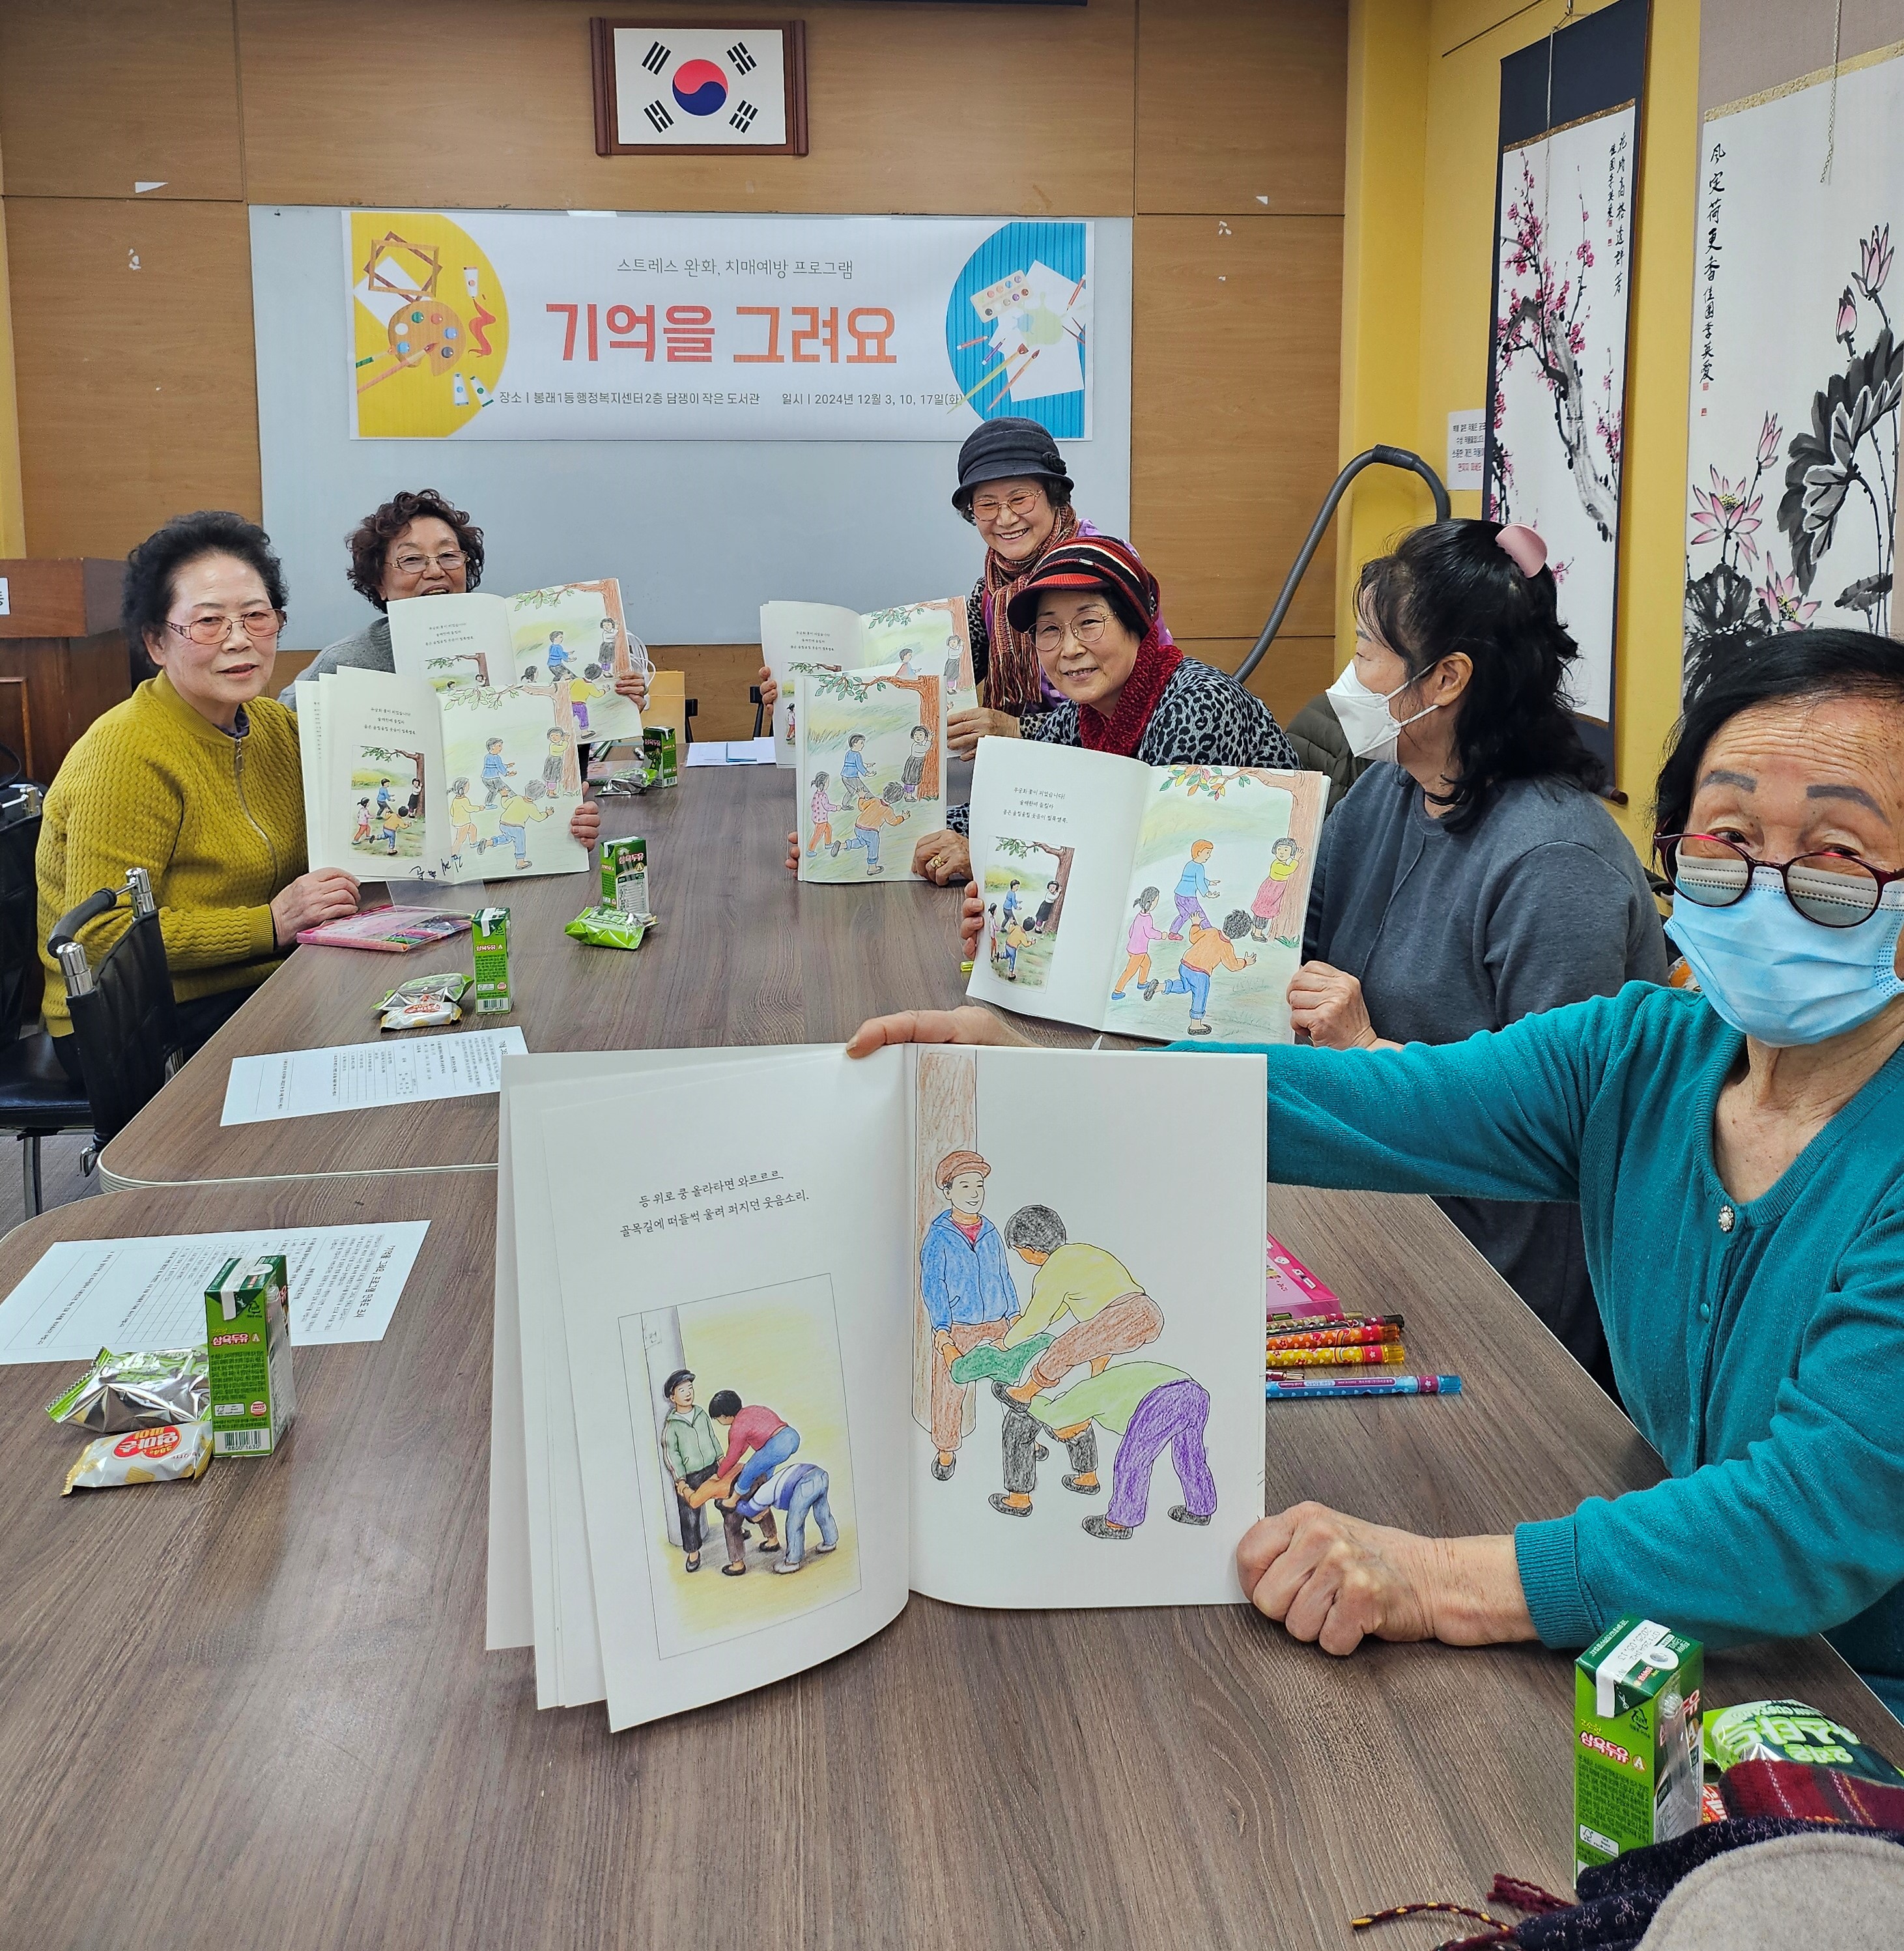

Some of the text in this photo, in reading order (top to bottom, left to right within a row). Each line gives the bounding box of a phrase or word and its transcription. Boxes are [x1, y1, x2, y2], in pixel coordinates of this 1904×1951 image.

[617, 257, 853, 279] 스트레스 완화, 치매예방 프로그램
[546, 304, 897, 363] 기억을 그려요
[500, 392, 522, 404] 장소
[666, 392, 699, 405] 담쟁이
[702, 393, 724, 405] 작은
[727, 393, 760, 405] 도서관
[782, 393, 963, 406] 일시 2024년 12월 3, 10, 17일(화)
[638, 1195, 651, 1208] 등
[653, 1191, 675, 1205] 위로
[677, 1187, 689, 1201] 쿵
[691, 1180, 735, 1198] 올라타면
[619, 1189, 810, 1238] 골목길에 떠들썩 울려 퍼지던 웃음소리.
[211, 1332, 261, 1346] 삼육두유 A
[118, 1431, 178, 1453] 엄마손
[1579, 1730, 1631, 1765] 삼육두유
[1633, 1756, 1645, 1771] A
